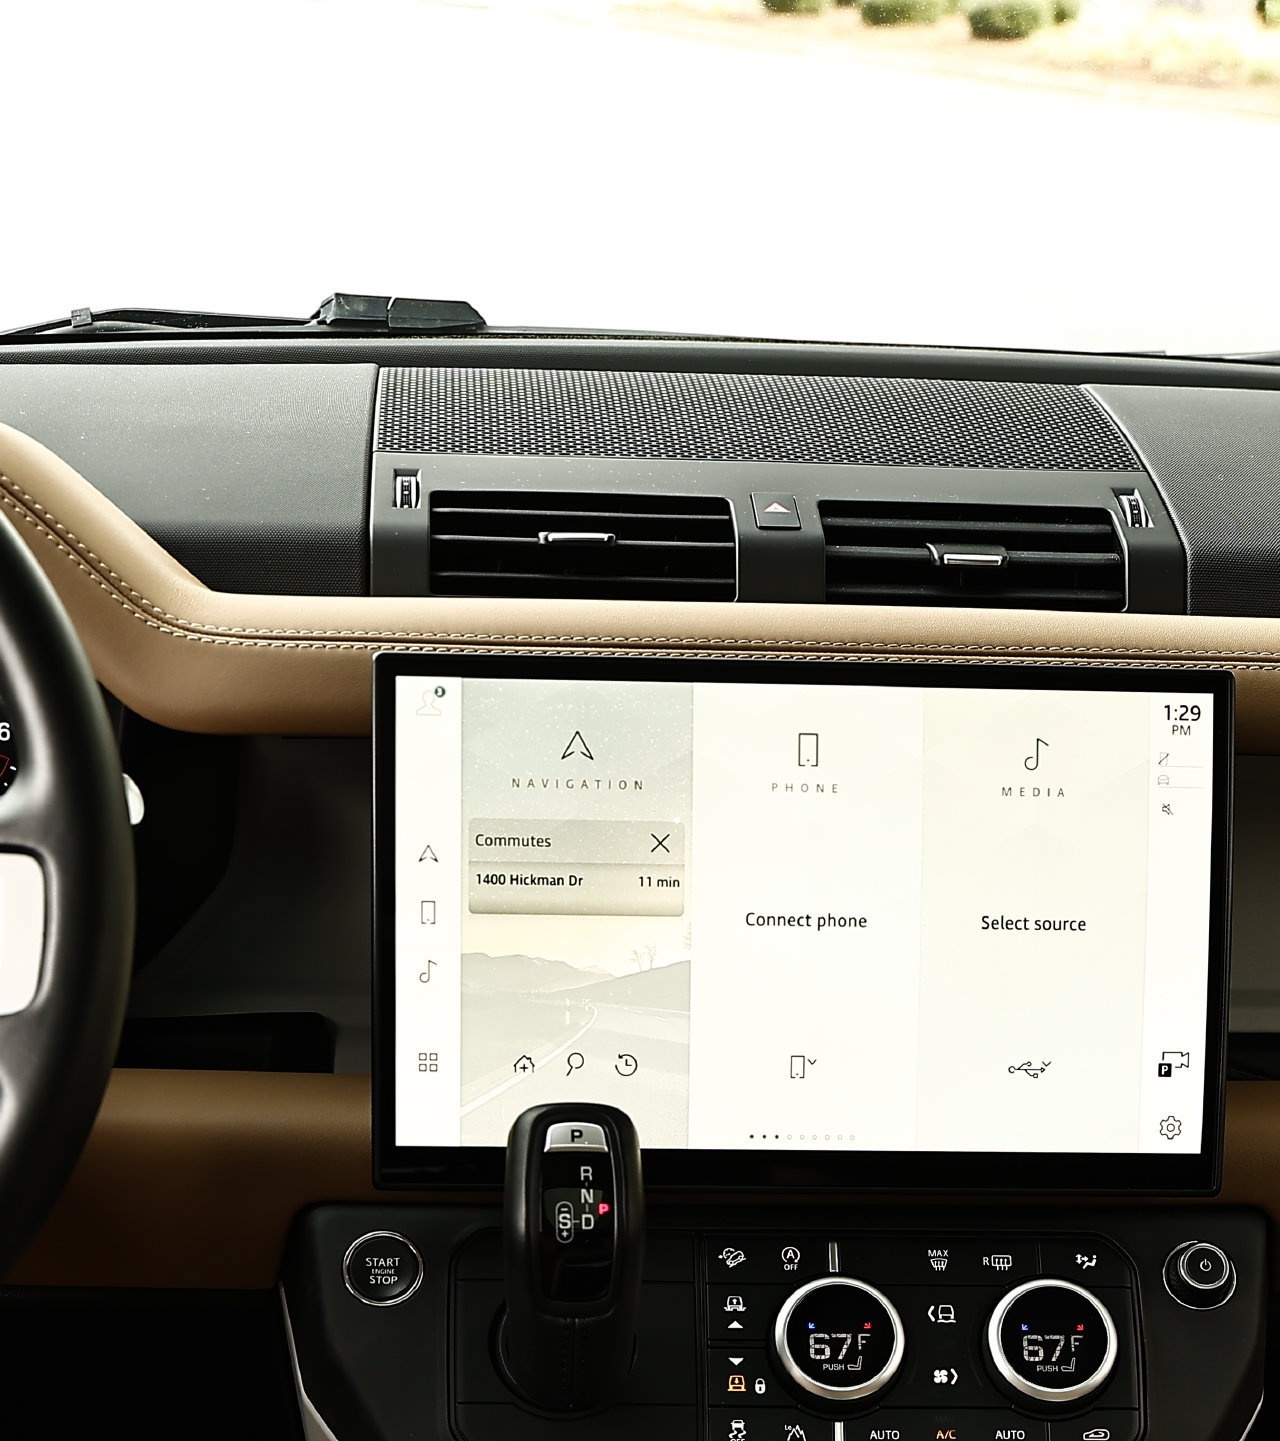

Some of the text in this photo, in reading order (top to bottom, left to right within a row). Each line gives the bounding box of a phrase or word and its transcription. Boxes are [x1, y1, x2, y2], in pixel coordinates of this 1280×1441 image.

[1164, 704, 1202, 722] 1:29
[1171, 724, 1191, 736] PM
[511, 777, 644, 791] NAVIGATION
[771, 782, 839, 794] PHONE
[1001, 786, 1066, 798] MEDIA
[475, 834, 552, 848] Commutes
[476, 873, 584, 887] 1400 Hickman Dr
[638, 876, 681, 888] 11 min
[745, 912, 868, 931] Connect phone
[980, 915, 1087, 931] Select source
[570, 1129, 583, 1143] P
[580, 1166, 593, 1181] R
[581, 1188, 594, 1204] N
[598, 1203, 610, 1215] P
[558, 1213, 595, 1230] S D
[927, 1249, 949, 1257] MAX
[365, 1257, 400, 1267] START
[783, 1263, 799, 1271] OFF
[982, 1257, 990, 1266] R
[369, 1275, 398, 1285] STOP
[822, 1363, 845, 1371] PUSH
[869, 1430, 900, 1440] AUTO
[936, 1429, 957, 1440] A/C
[995, 1430, 1026, 1440] AUTO
